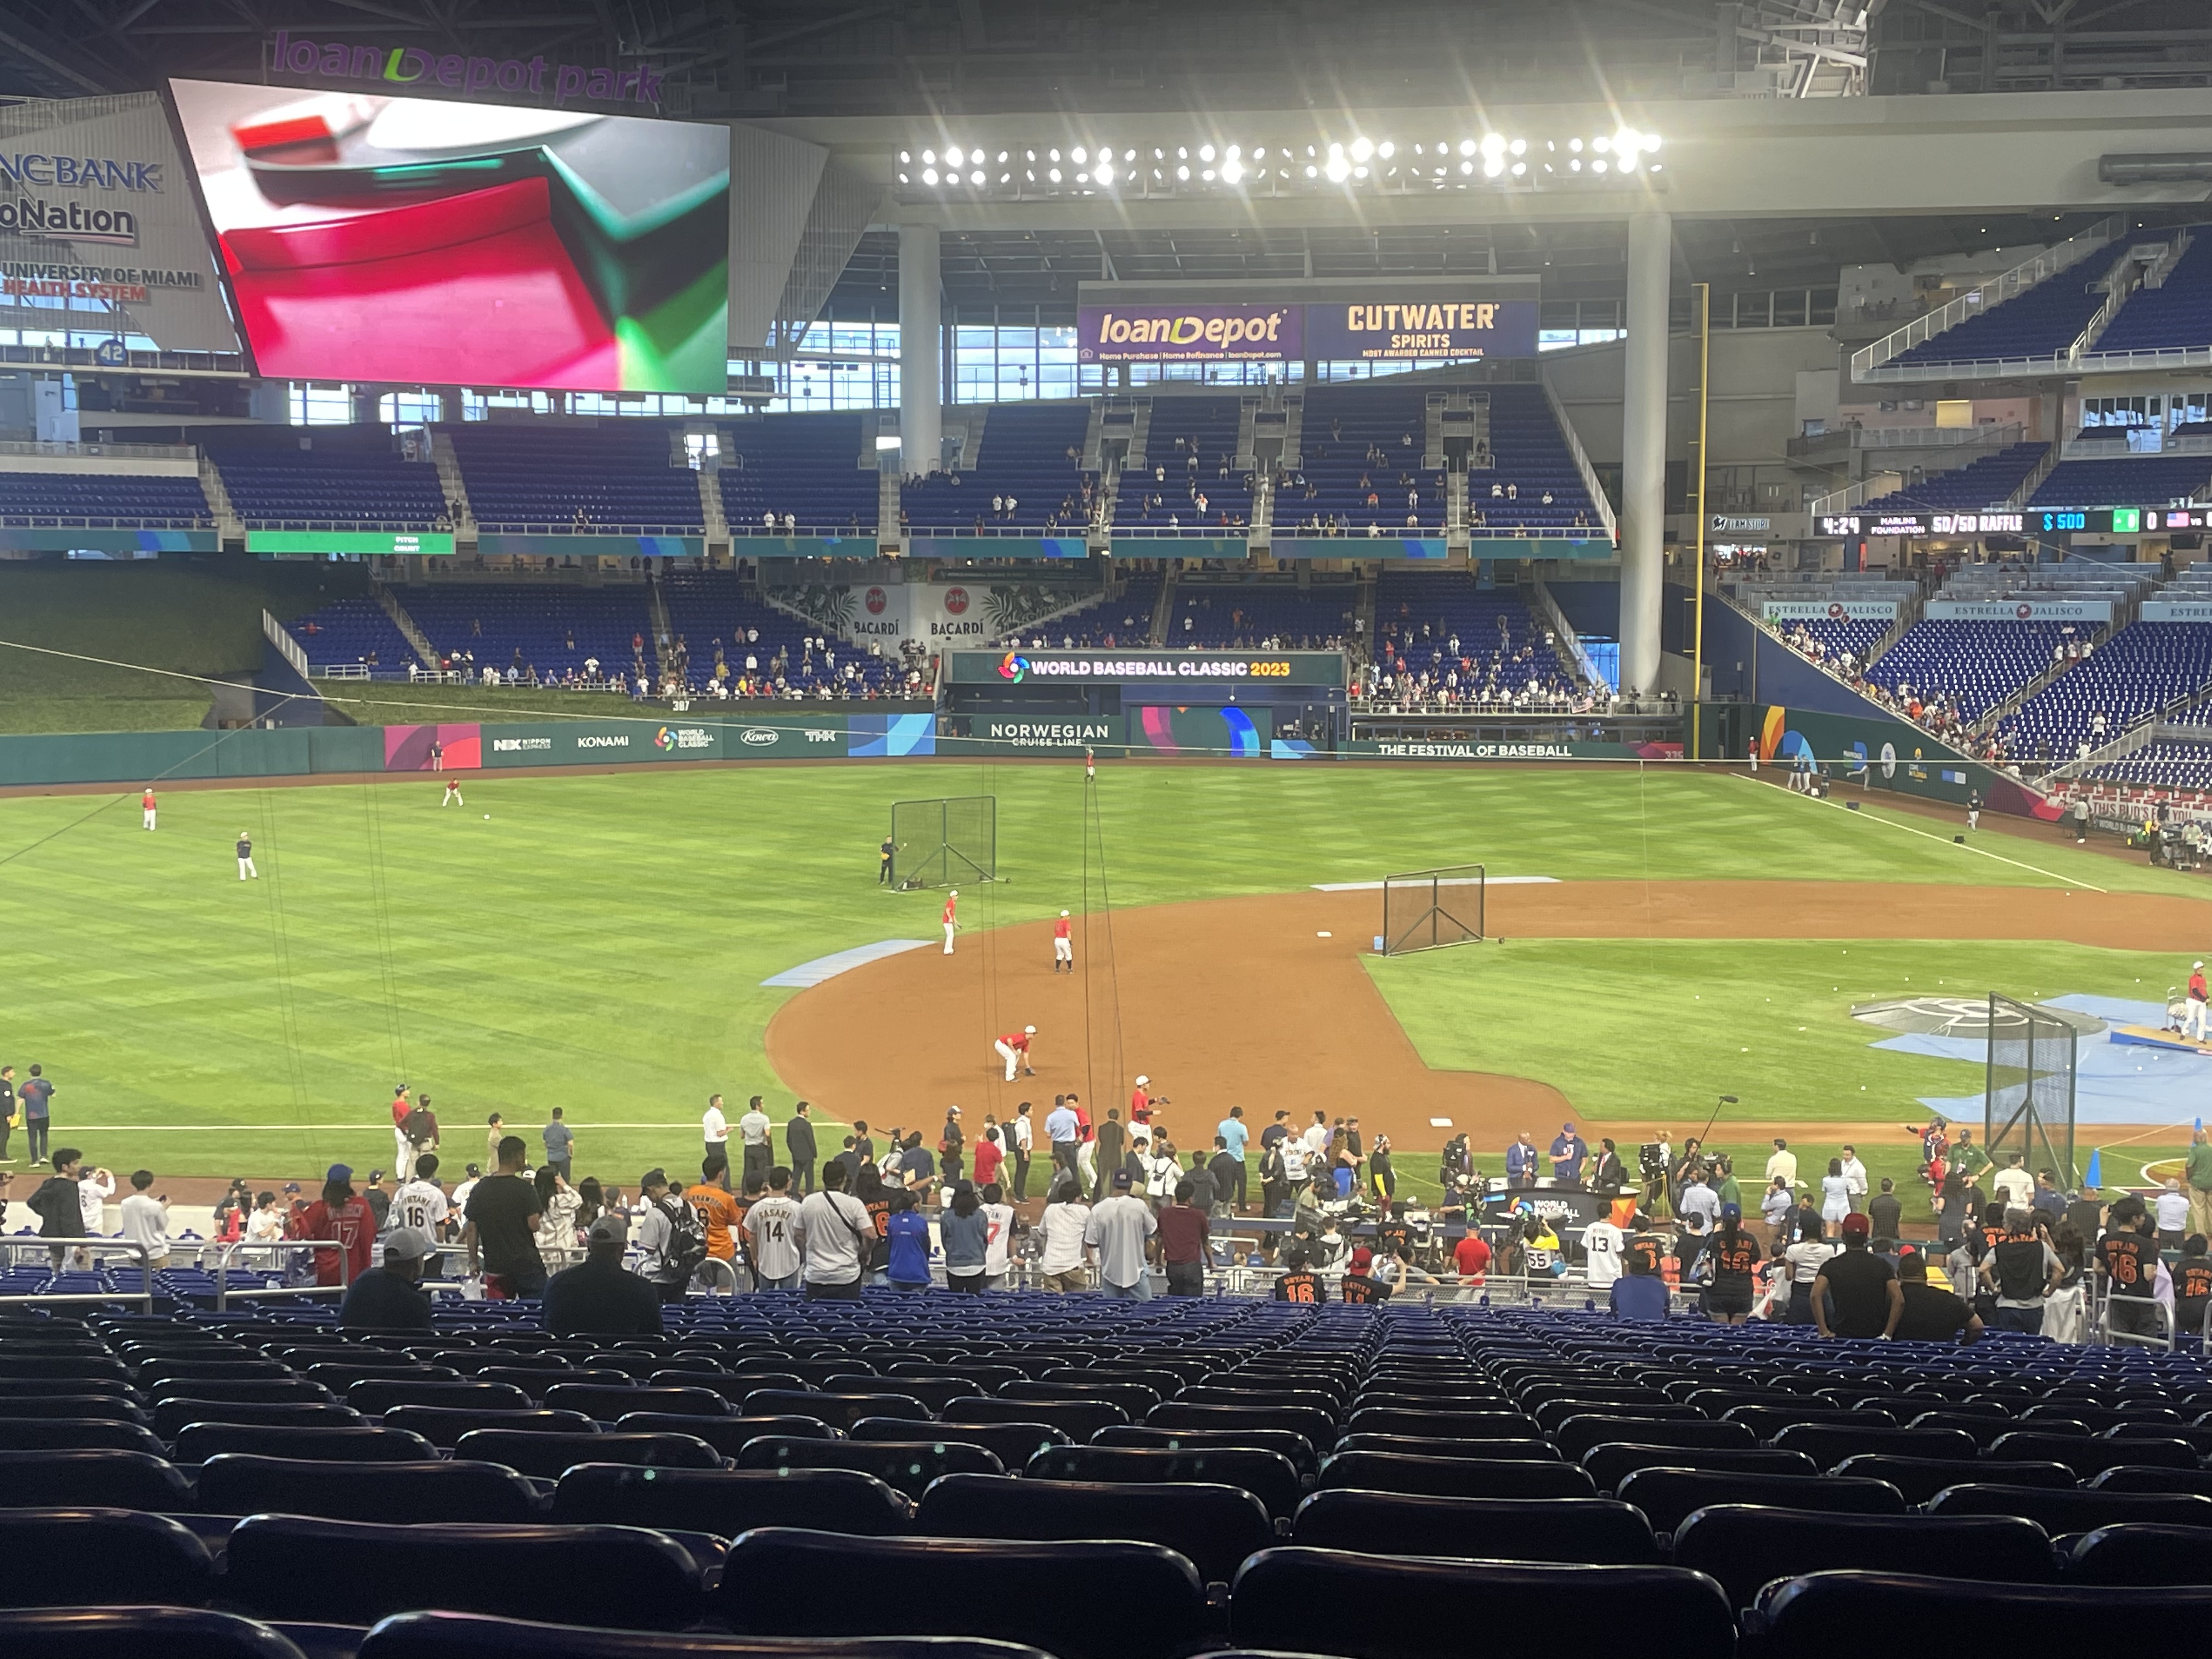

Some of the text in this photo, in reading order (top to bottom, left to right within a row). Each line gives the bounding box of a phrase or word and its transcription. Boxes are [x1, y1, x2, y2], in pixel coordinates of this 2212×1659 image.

[273, 30, 663, 105] loanDepot park
[2, 262, 199, 287] UNIVERSITY OF MIAMI
[4, 279, 146, 301] HEALTH SYSTEM
[1099, 304, 1494, 349] loanDepot CUTWATER
[1391, 334, 1451, 348] SPIRITS
[100, 345, 123, 360] 42
[1823, 517, 1859, 534] 4:24
[1871, 526, 1925, 534] FOUNDATION
[1933, 514, 2023, 534] 50/50 RAFFLE
[1768, 606, 1826, 614] ESTRELLA
[1955, 606, 2083, 615] ESTRELLA JALISCO
[1031, 661, 1290, 676] WORLD BASEBALL CLASSIC 2023
[744, 731, 777, 742] Kowa
[991, 724, 1108, 738] NORWEGIAN
[578, 736, 629, 747] KONAMI
[1012, 737, 1052, 747] CRUISE
[1378, 744, 1572, 757] THE FESTIVAL OF BASEBALL
[2093, 802, 2116, 815] THIS
[2172, 809, 2192, 822] YOU
[1533, 1199, 1568, 1209] WORLD
[407, 1206, 424, 1228] 16
[758, 1209, 792, 1220] SASAKI
[765, 1221, 785, 1243] 14
[1592, 1236, 1609, 1252] 13
[1527, 1251, 1547, 1267] 55
[2108, 1252, 2137, 1284] 16
[1286, 1283, 1314, 1304] 16
